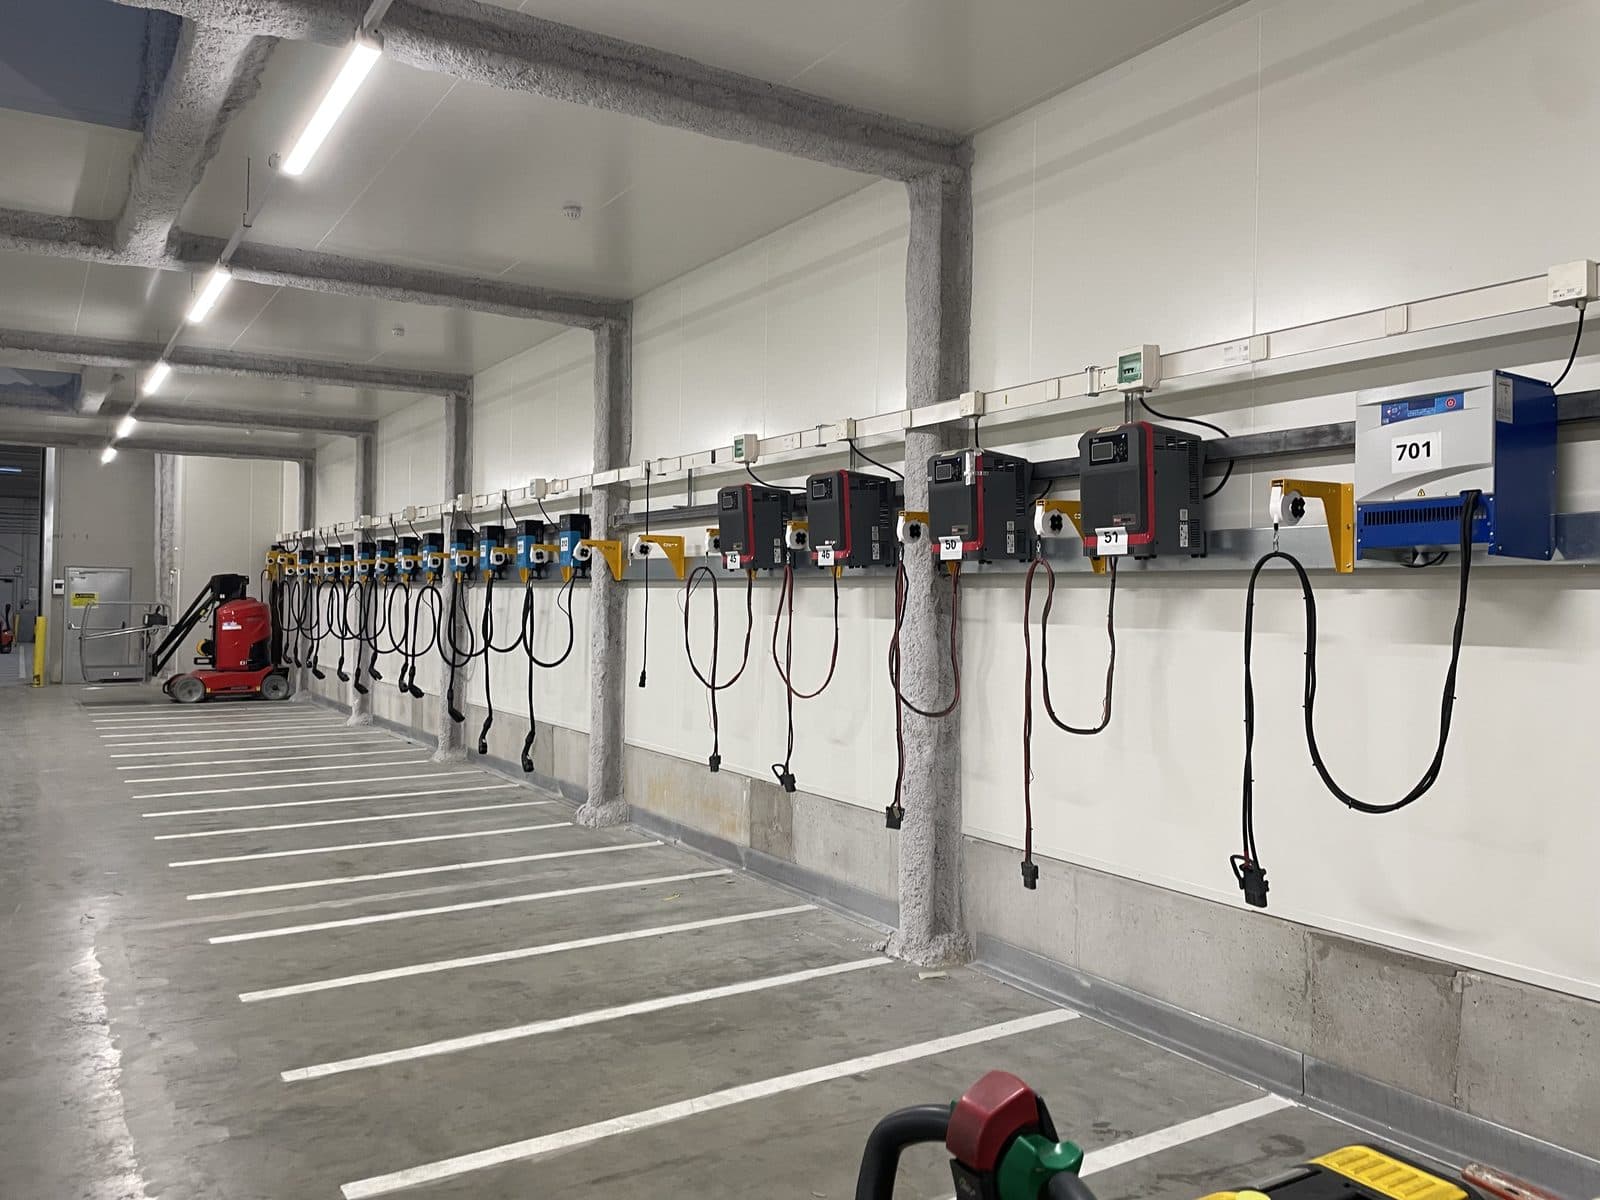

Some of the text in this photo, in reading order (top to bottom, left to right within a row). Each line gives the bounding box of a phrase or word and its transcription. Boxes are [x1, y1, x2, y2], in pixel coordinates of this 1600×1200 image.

[1396, 440, 1431, 461] 701
[1103, 530, 1119, 544] 51
[945, 539, 957, 550] 50
[821, 549, 831, 559] 46
